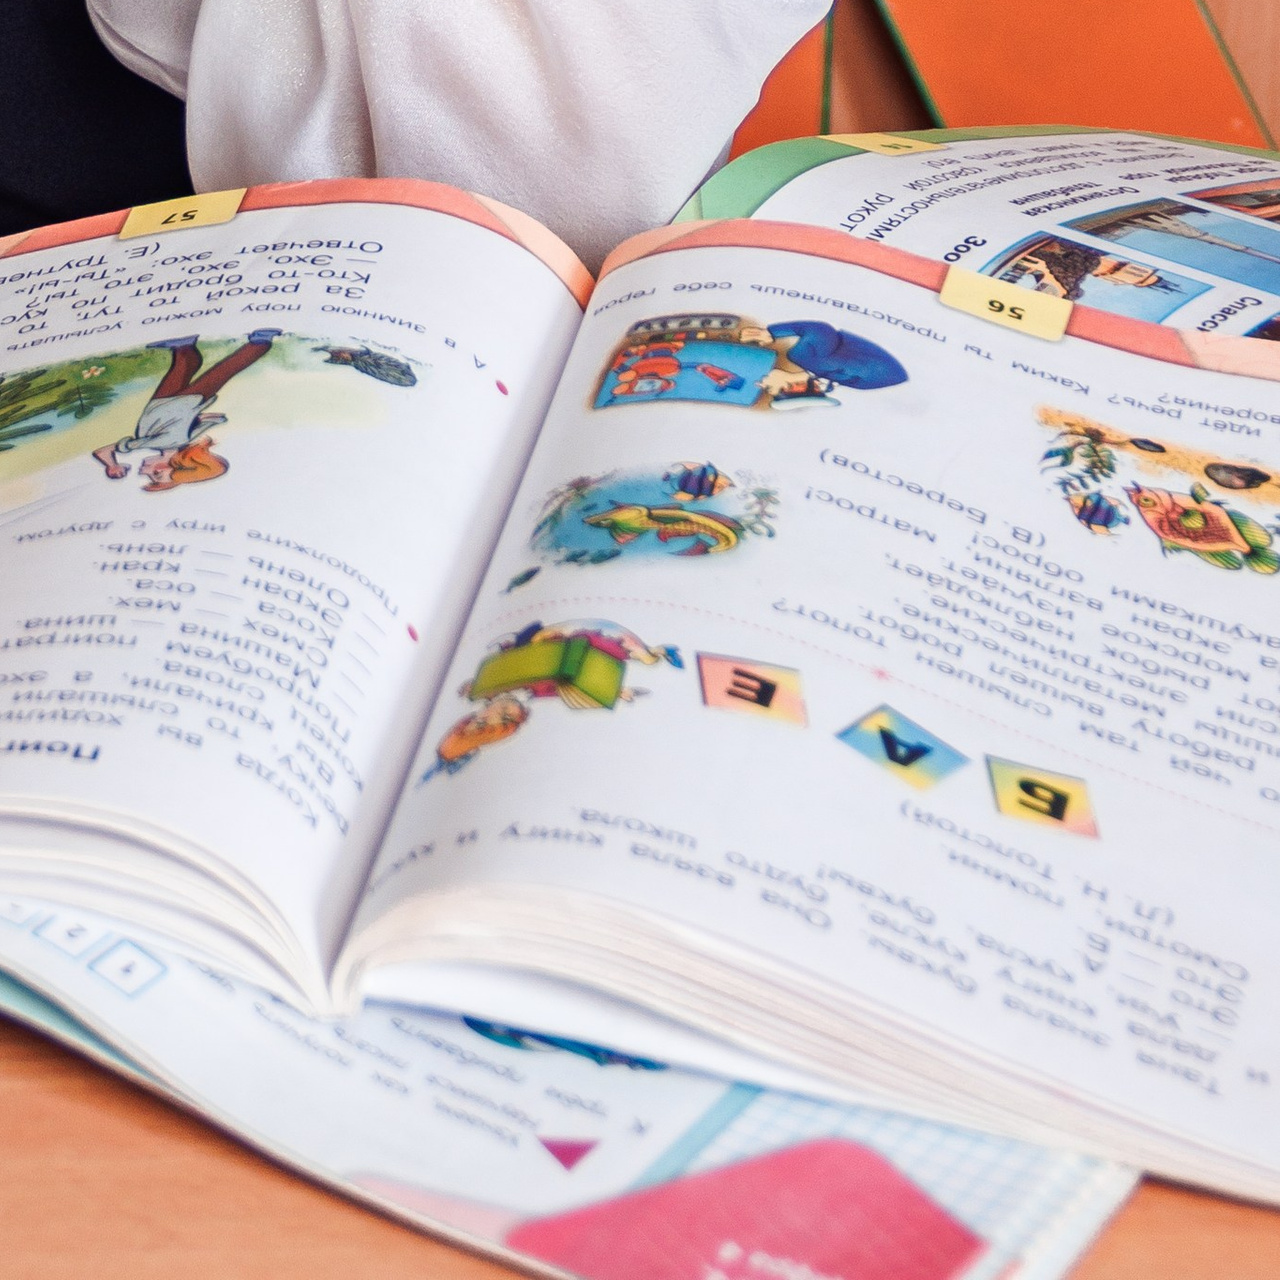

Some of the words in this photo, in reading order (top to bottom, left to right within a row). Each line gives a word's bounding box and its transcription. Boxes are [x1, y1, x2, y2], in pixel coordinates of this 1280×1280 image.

[160, 209, 198, 226] 57
[124, 241, 161, 260] (Е.
[150, 250, 214, 270] эхо:
[234, 239, 384, 263] Отвечает
[263, 247, 334, 272] Эхо,
[173, 255, 240, 277] эхо,
[267, 262, 371, 290] Кто-то
[98, 272, 154, 291] это
[124, 265, 245, 303] бродит
[204, 277, 301, 303] рекой
[325, 280, 370, 300] За
[672, 281, 733, 293] себе
[23, 288, 83, 315] ты?
[66, 293, 108, 312] по
[70, 298, 122, 321] тут,
[148, 295, 180, 308] то
[240, 302, 302, 313] пору
[749, 284, 947, 344] представляешь
[987, 299, 1025, 321] 56
[1196, 284, 1264, 333] Спасс
[12, 316, 47, 335] то
[140, 306, 224, 326] можно
[319, 304, 424, 334] зимнюю
[5, 318, 123, 352] услышать
[443, 336, 457, 349] в
[963, 343, 993, 361] ты
[1010, 360, 1091, 396] Каким
[1106, 393, 1187, 421] речь?
[1199, 417, 1262, 438] идёт
[818, 448, 988, 526] Берестов)
[130, 519, 147, 531] с
[165, 517, 226, 534] игру
[804, 486, 937, 544] матрос!
[11, 520, 114, 545] другом.
[1002, 520, 1046, 548] (В.
[99, 543, 187, 556] лень.
[966, 533, 1085, 584] оброс!
[93, 558, 181, 574] кран.
[244, 528, 398, 617] Продолжите
[127, 578, 197, 595] оса.
[247, 555, 351, 610] Олень
[108, 596, 182, 614] мех.
[240, 574, 343, 629] Экран
[16, 614, 117, 635] шина.
[256, 600, 336, 650] Коса
[1130, 612, 1231, 655] экран
[178, 621, 321, 690] Машина
[242, 616, 329, 669] Смех
[1100, 623, 1251, 684] морское
[1101, 643, 1212, 692] рыбок
[163, 639, 350, 744] Попробуем
[726, 668, 778, 709] Е
[878, 726, 932, 767] А
[1130, 717, 1257, 773] работу
[1017, 777, 1070, 822] Б
